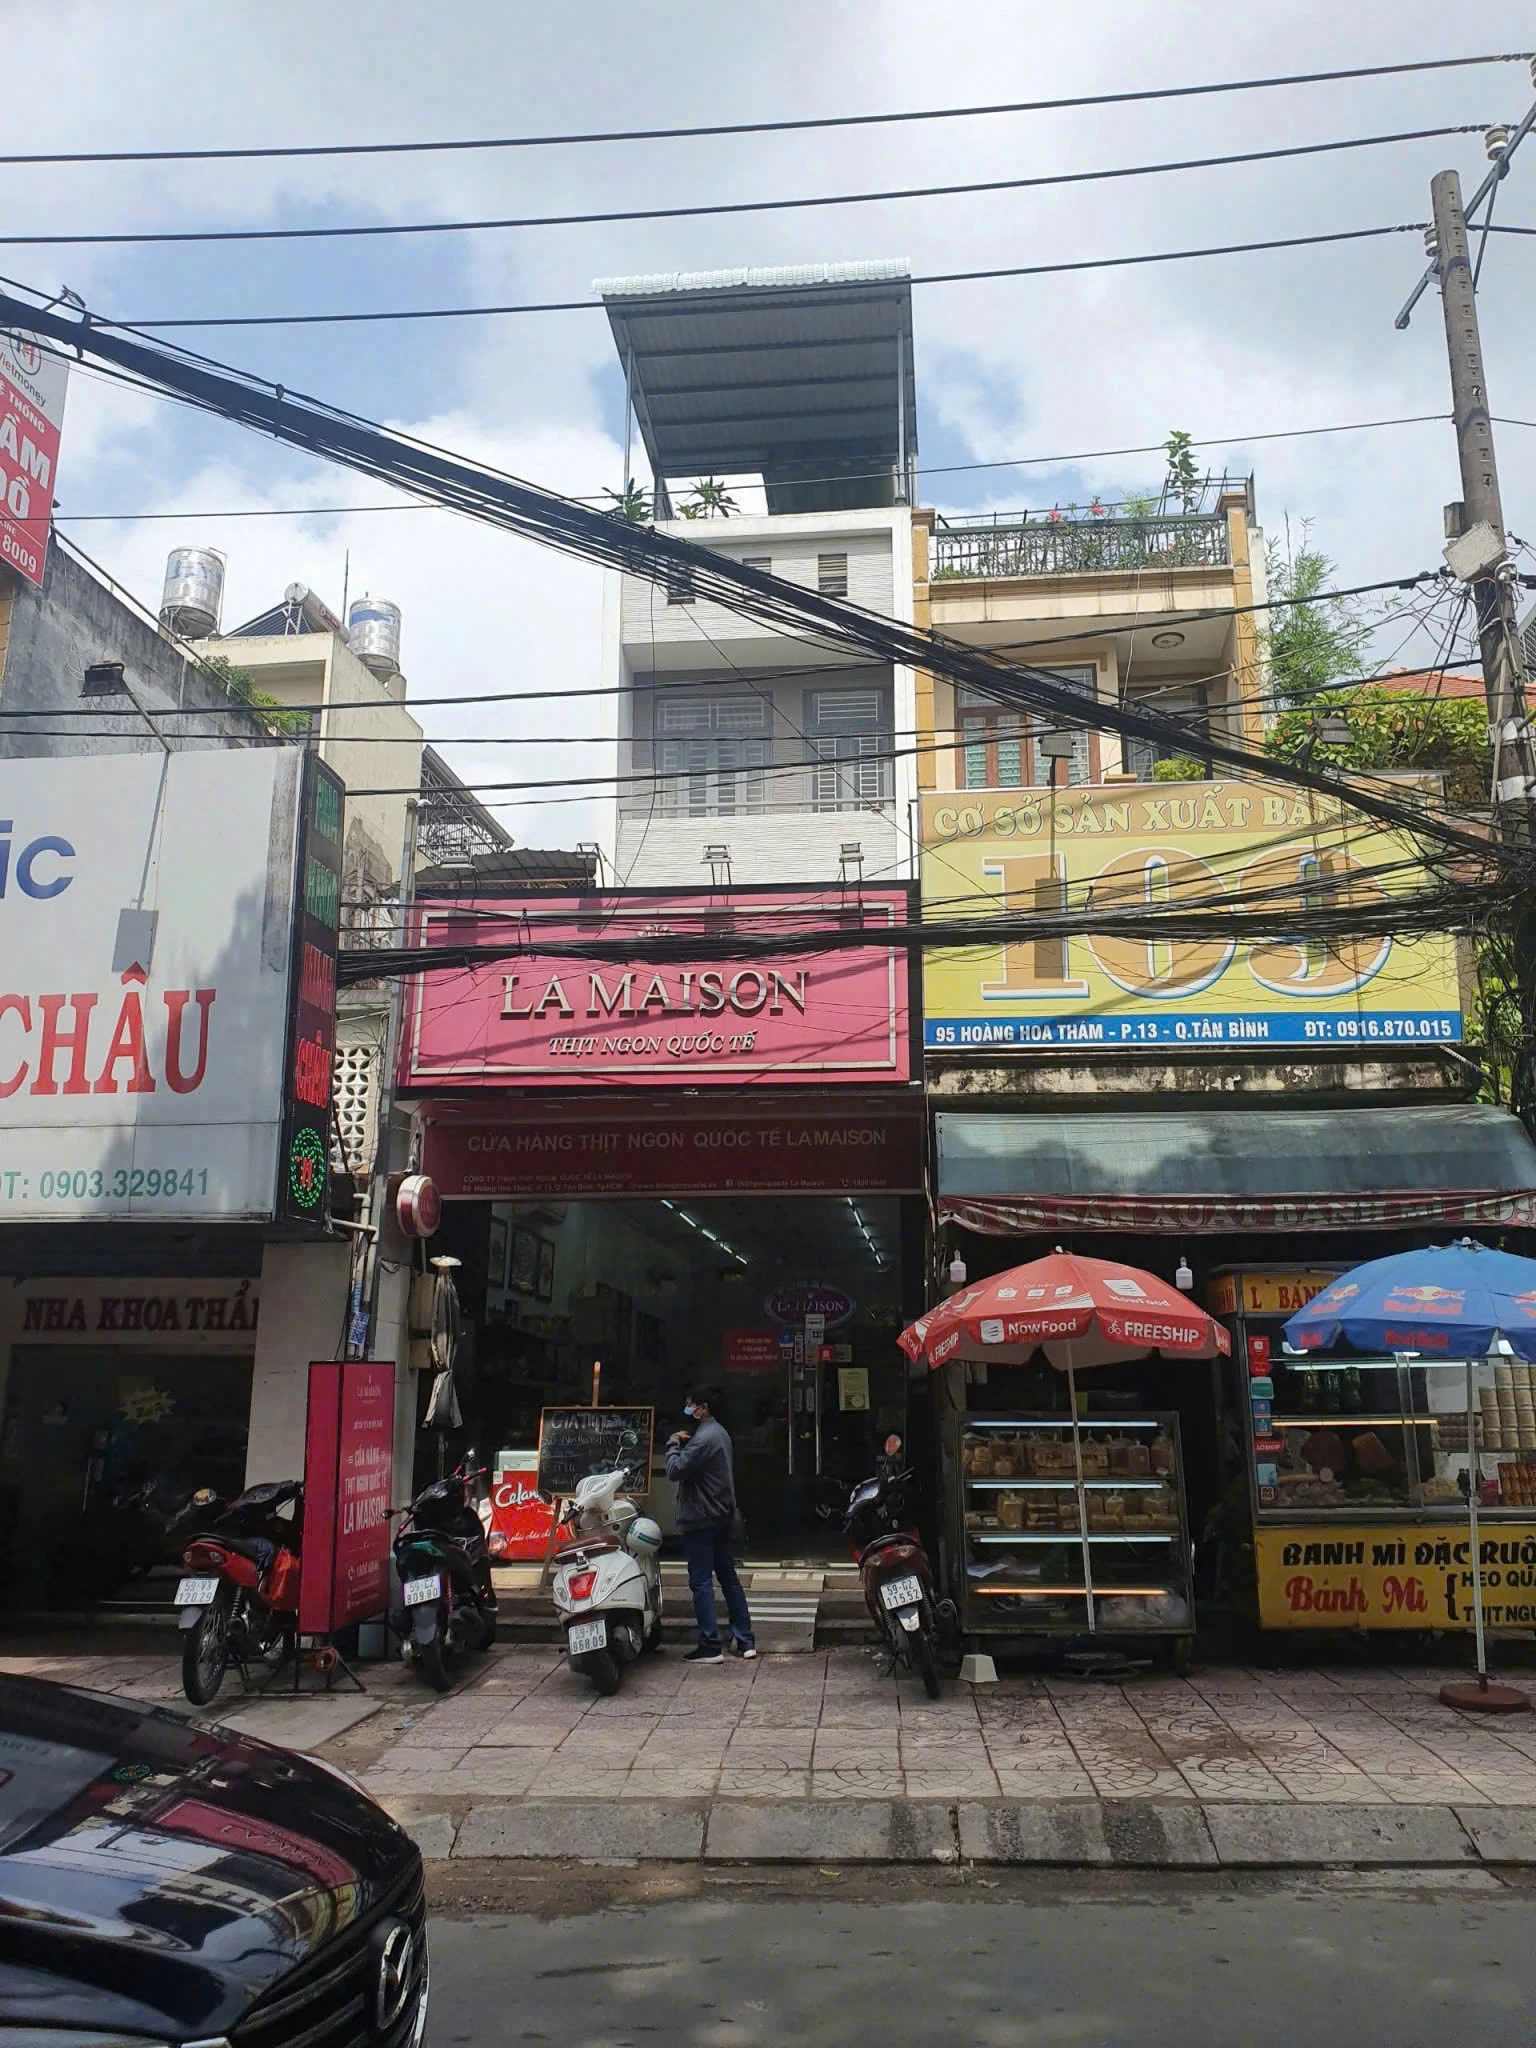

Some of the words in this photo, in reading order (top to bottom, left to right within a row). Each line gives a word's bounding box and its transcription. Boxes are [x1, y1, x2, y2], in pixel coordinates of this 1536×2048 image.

[3, 535, 37, 574] 8009
[934, 801, 985, 838] CƠ
[993, 794, 1044, 836] SỞ
[1053, 791, 1131, 834] SẢN
[1142, 784, 1253, 832] XUẤT
[500, 973, 575, 1017] LA
[587, 969, 809, 1017] MAISON
[550, 1036, 598, 1057] THỊT
[602, 1034, 663, 1054] NGON
[666, 1028, 724, 1053] QUỐC
[730, 1028, 758, 1050] TẾ
[936, 1026, 955, 1042] 95
[961, 1022, 1014, 1042] HOÀNG
[1020, 1025, 1052, 1041] HOA
[1057, 1020, 1103, 1040] THÁM
[1121, 1022, 1158, 1039] P.13
[1176, 1019, 1223, 1039] Q.TÂN
[1229, 1018, 1269, 1037] BÌNH
[1305, 1020, 1332, 1037] ĐT:
[1337, 1019, 1452, 1037] 0916.870.015
[468, 1131, 512, 1152] CỬA
[517, 1131, 573, 1151] HÀNG
[577, 1134, 622, 1153] THỊT
[628, 1132, 684, 1149] NGON
[0, 1171, 28, 1199] T:
[40, 1168, 209, 1199] 0903.329841
[24, 1298, 87, 1330] NHA
[97, 1297, 180, 1330] KHOA
[1008, 1318, 1077, 1336] NowFood
[1124, 1321, 1199, 1343] FREESHIP
[344, 1502, 354, 1535] LA
[1372, 1536, 1407, 1566] MÌ
[1415, 1536, 1470, 1571] ĐẶC
[1285, 1575, 1369, 1612] Bánh
[1383, 1575, 1428, 1613] Mì
[1462, 1570, 1501, 1588] HEO
